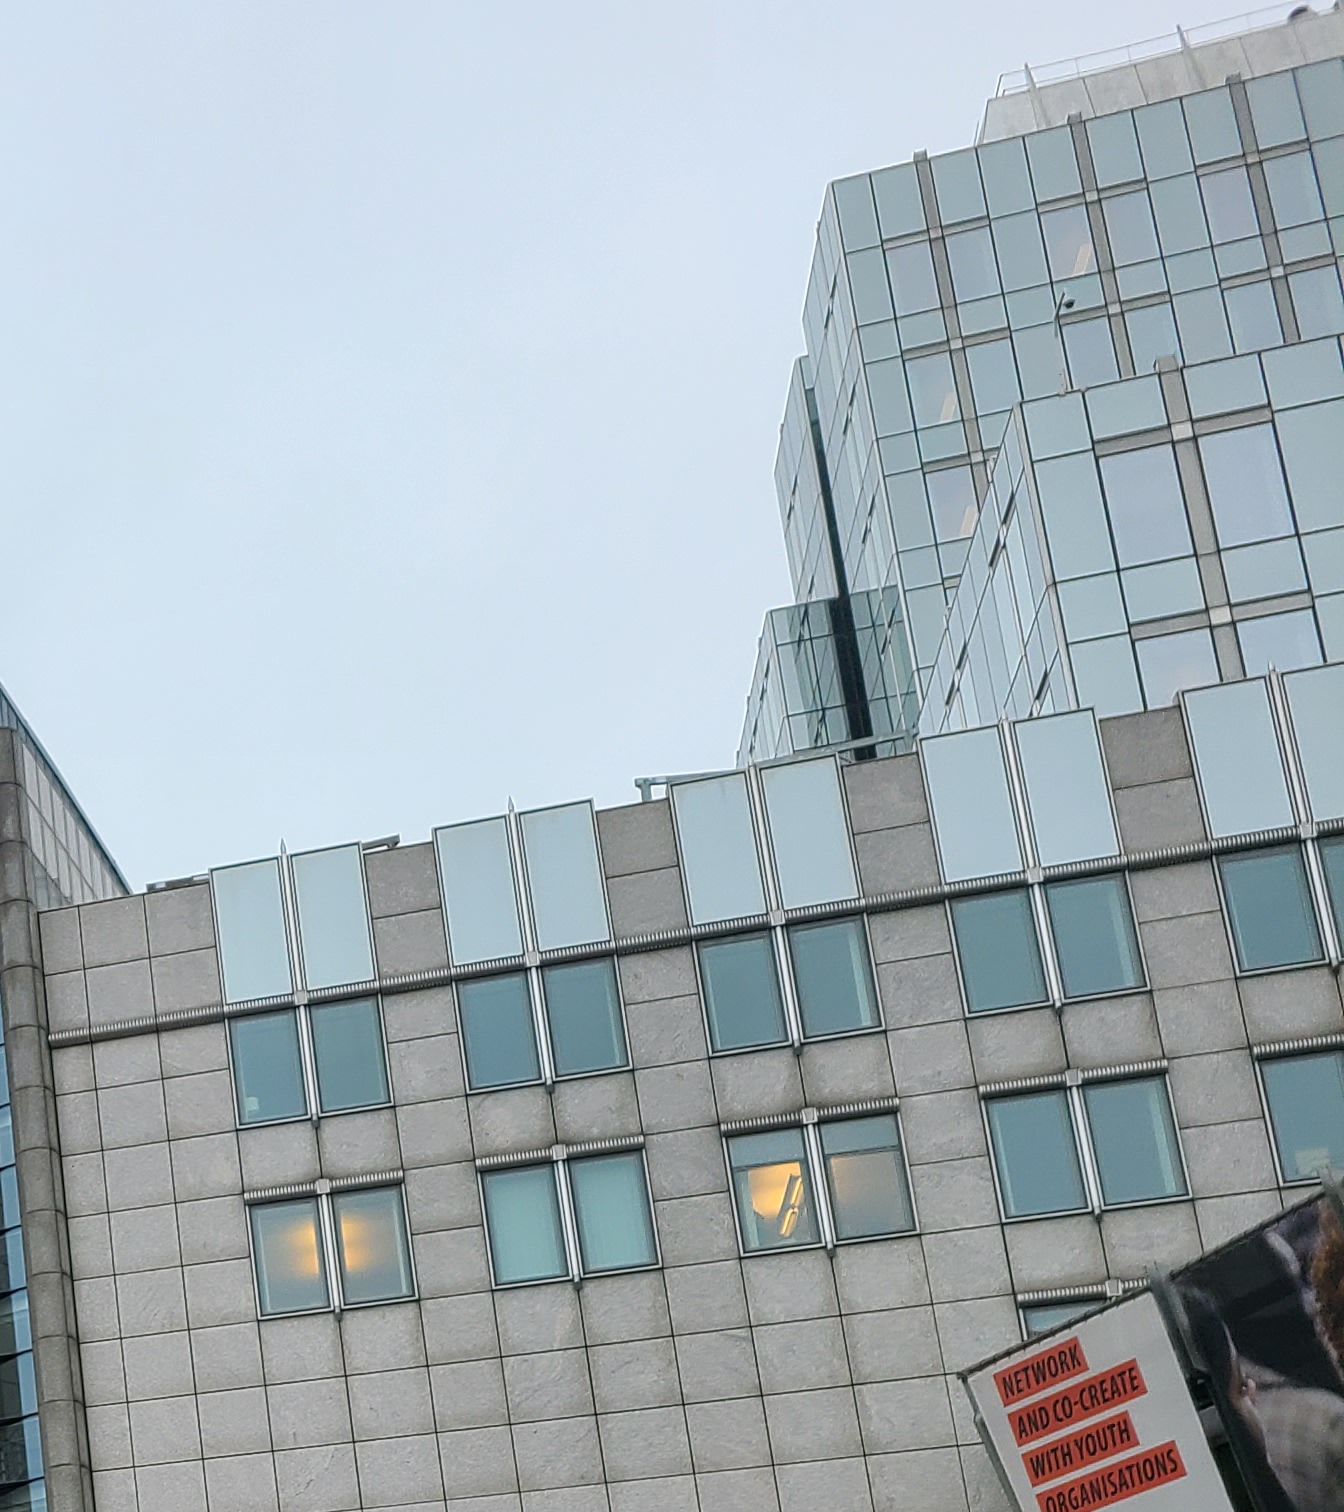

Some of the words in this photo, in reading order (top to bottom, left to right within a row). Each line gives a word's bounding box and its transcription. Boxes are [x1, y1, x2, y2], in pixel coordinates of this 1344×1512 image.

[1002, 1344, 1082, 1399] NETWORK
[1017, 1406, 1050, 1439] AND
[1053, 1367, 1140, 1423] CO-CREATE
[1029, 1447, 1073, 1479] WITH
[1073, 1418, 1131, 1460] YOUTH
